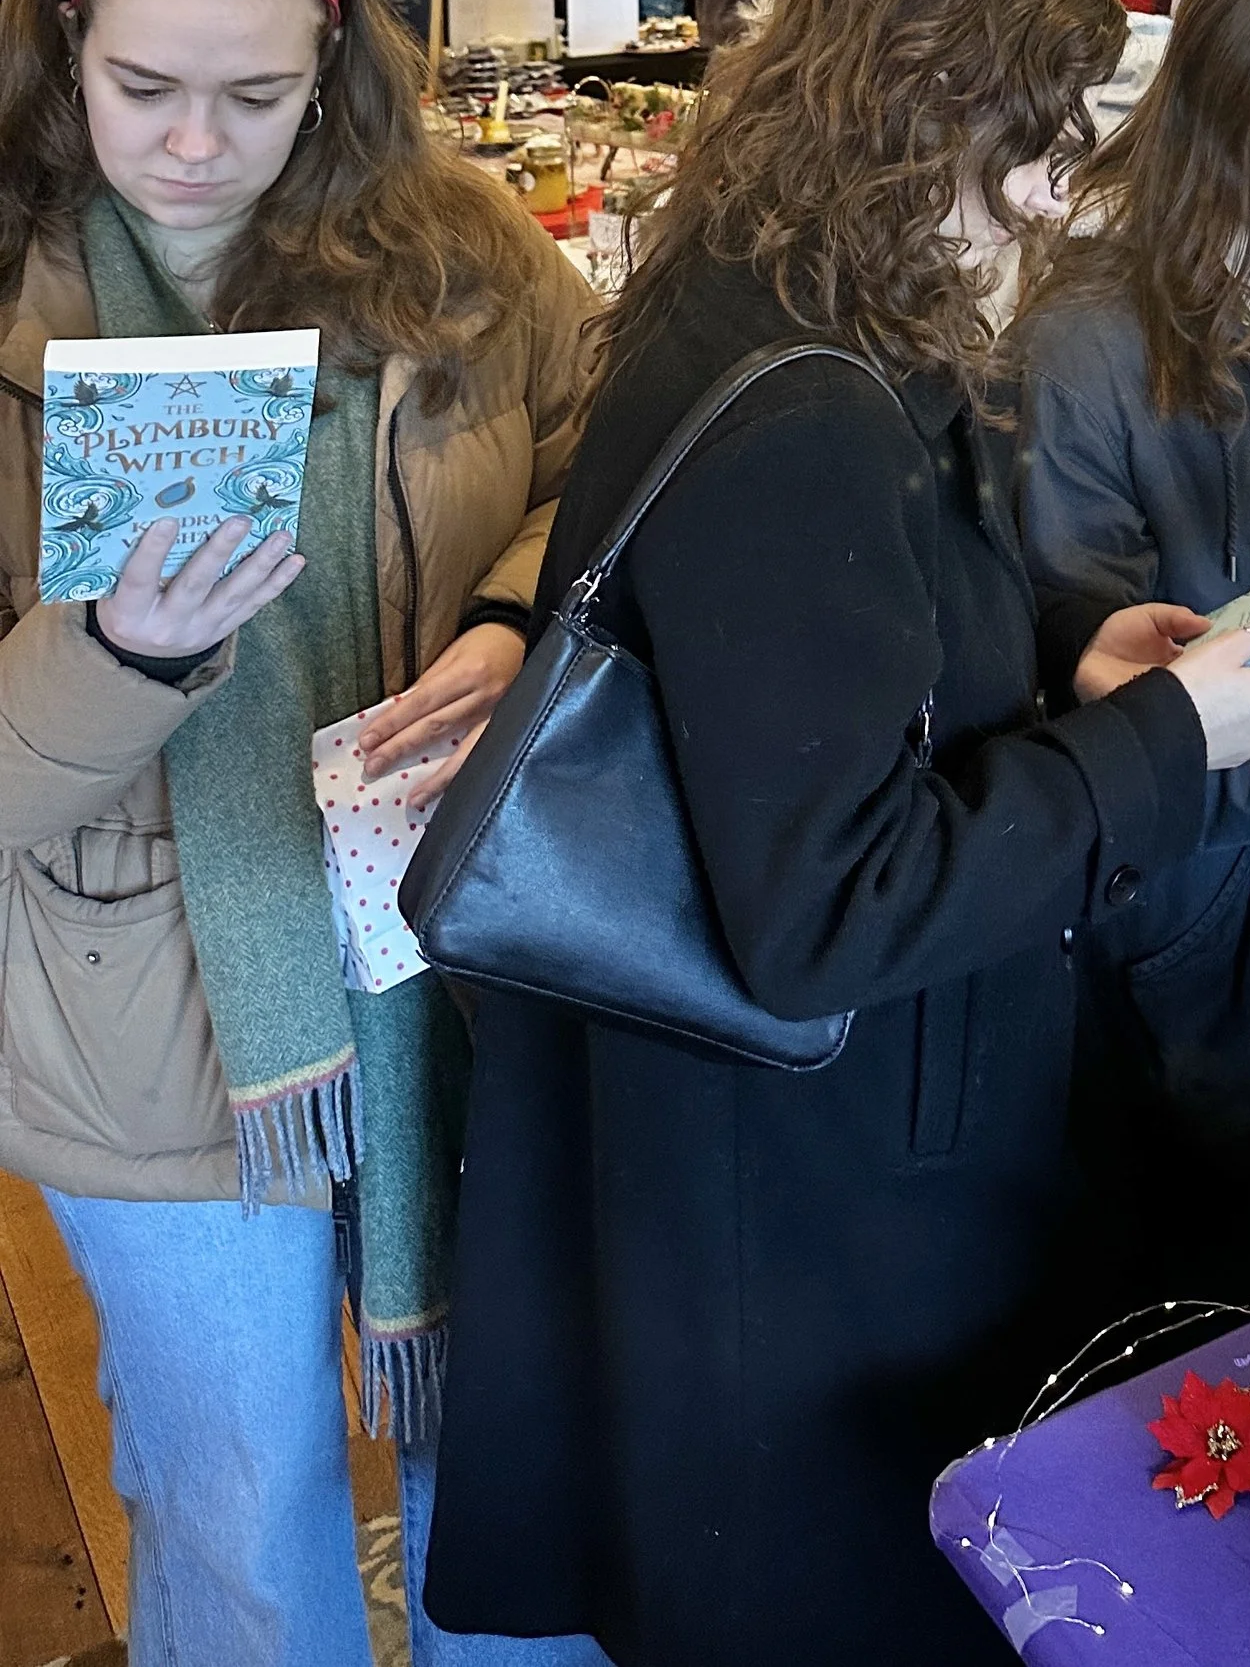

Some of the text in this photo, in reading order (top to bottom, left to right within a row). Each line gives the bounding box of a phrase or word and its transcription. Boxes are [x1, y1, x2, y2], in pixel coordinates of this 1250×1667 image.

[163, 404, 205, 416] THE
[74, 417, 285, 459] PLYMBURY
[104, 445, 246, 475] WITCH
[132, 513, 222, 533] KDRA
